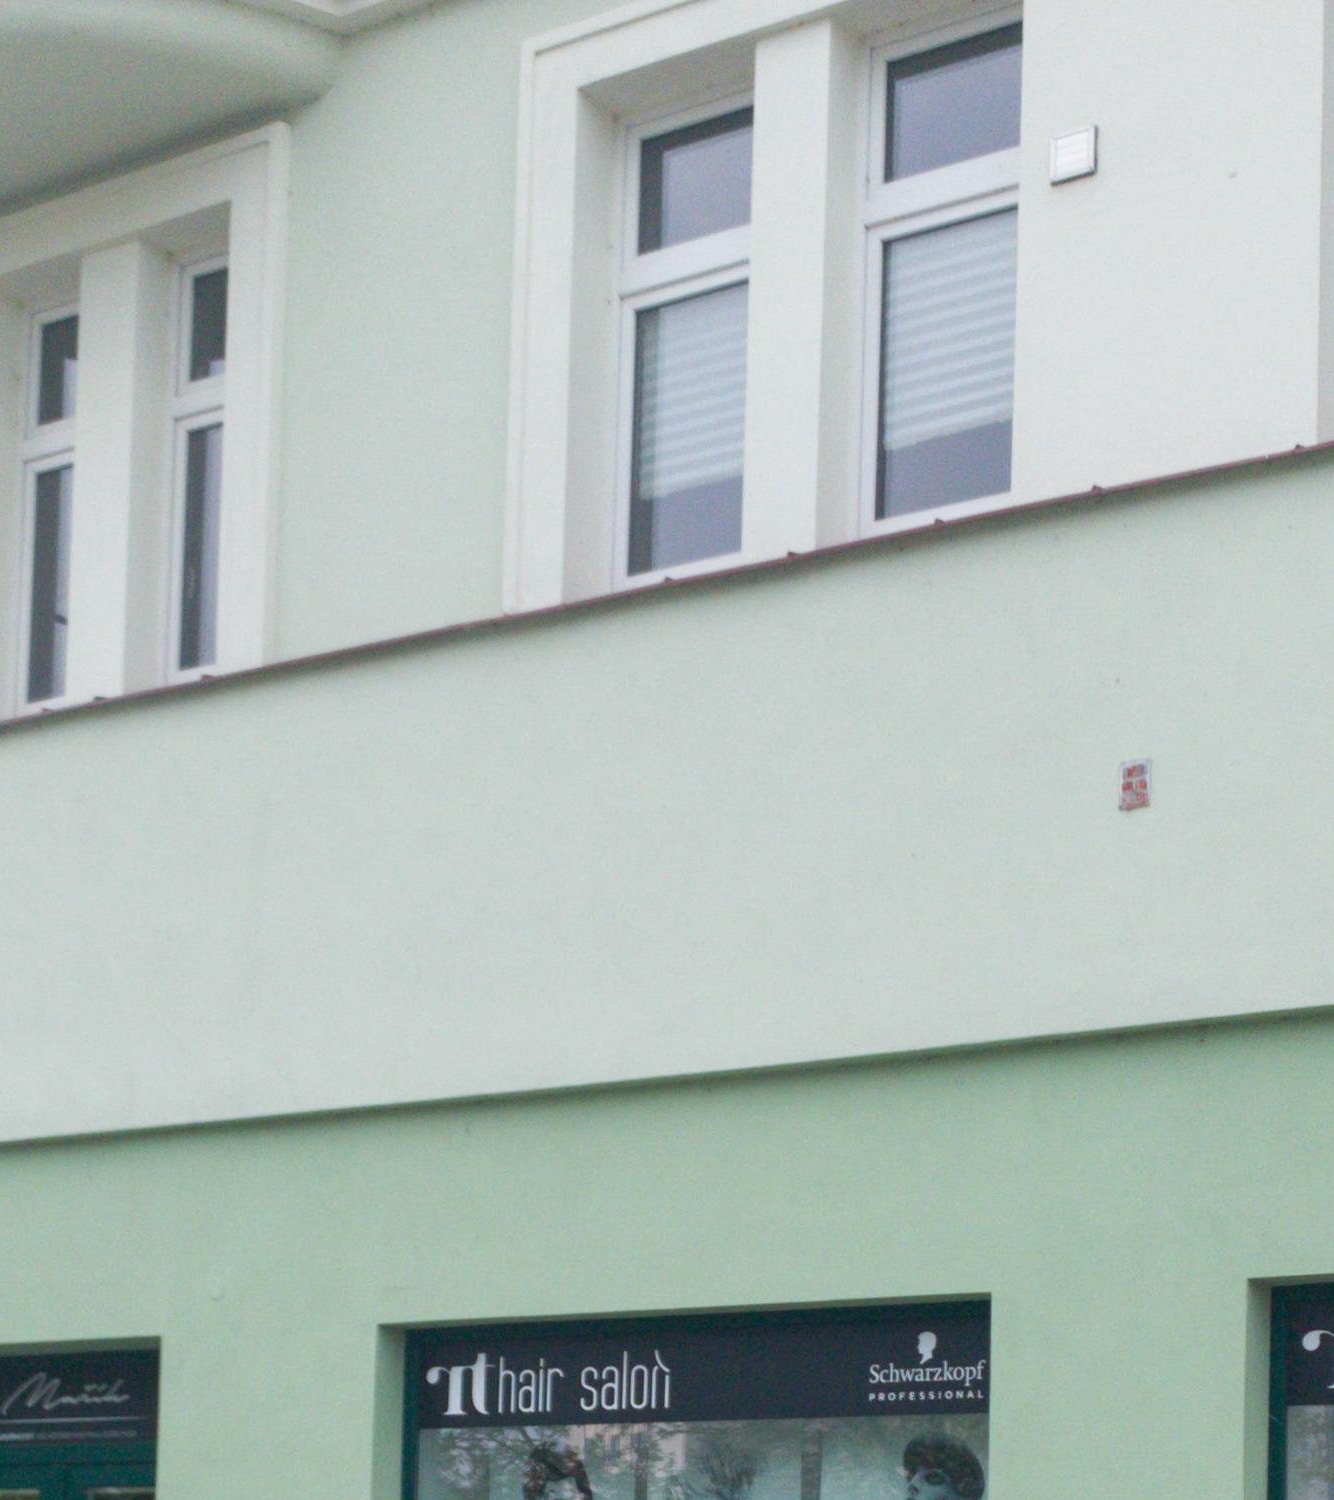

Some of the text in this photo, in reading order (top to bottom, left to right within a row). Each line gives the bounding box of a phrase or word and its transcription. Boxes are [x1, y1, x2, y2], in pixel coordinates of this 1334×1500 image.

[498, 1355, 565, 1413] hair
[868, 1359, 987, 1386] Schwarzkopf
[868, 1389, 984, 1401] PROFESSIONAL
